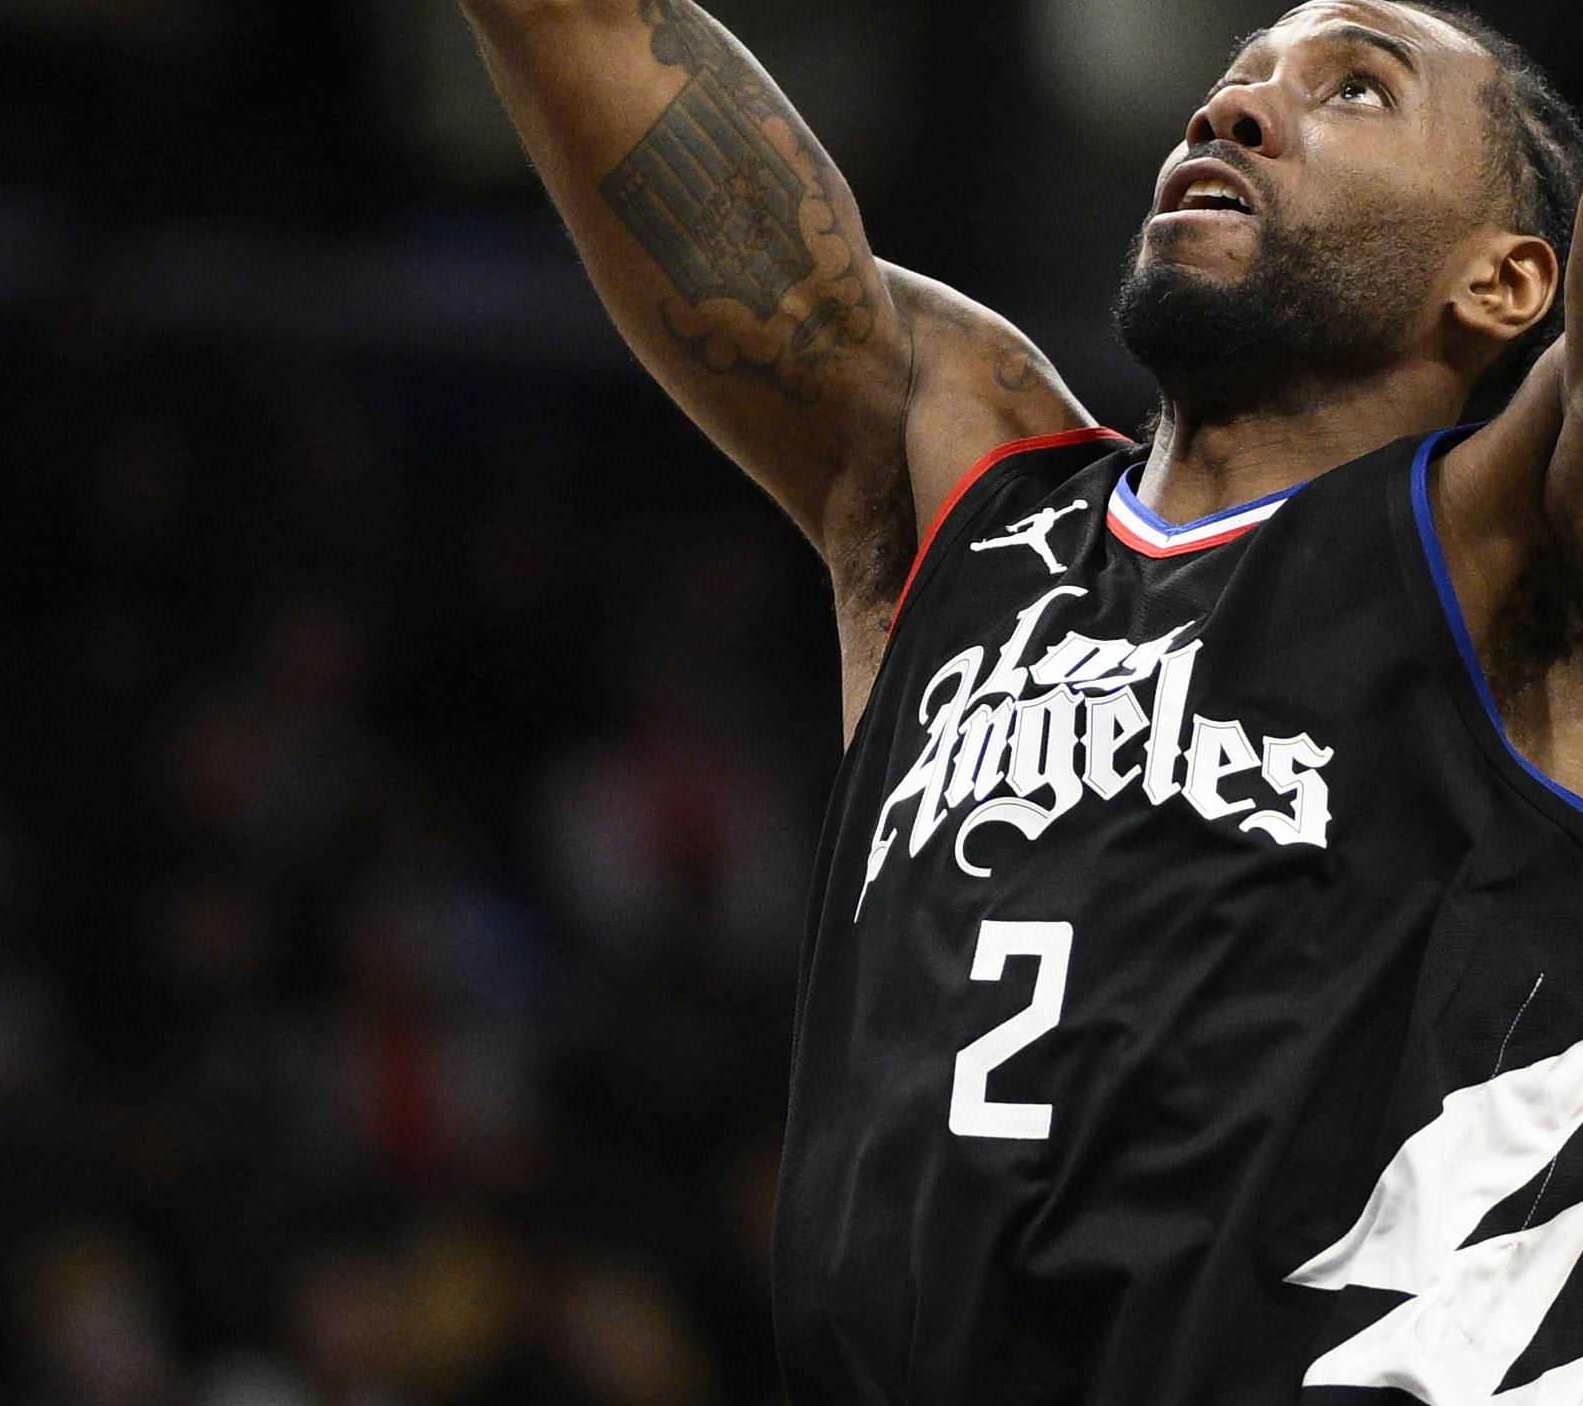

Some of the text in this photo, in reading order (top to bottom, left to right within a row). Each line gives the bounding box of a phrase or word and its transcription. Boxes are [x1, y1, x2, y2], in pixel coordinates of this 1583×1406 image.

[977, 586, 1199, 697] Los
[853, 637, 1335, 924] Angeles
[948, 919, 1075, 1140] 2
